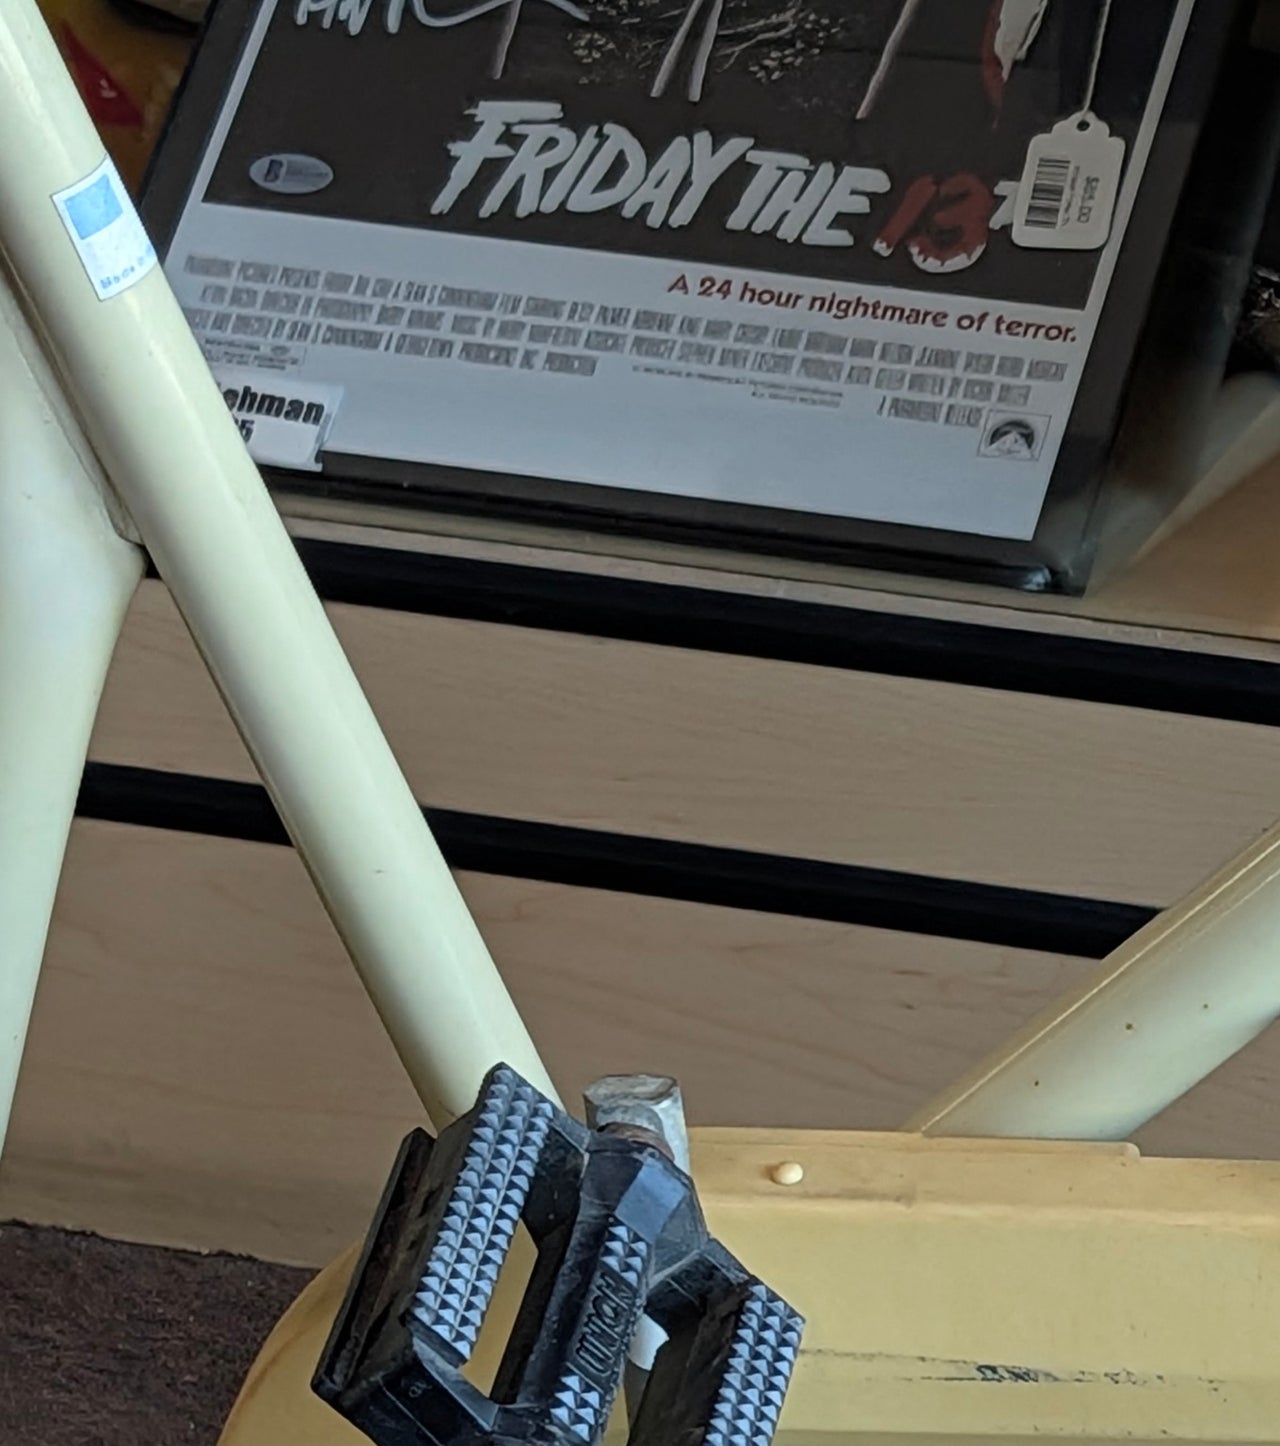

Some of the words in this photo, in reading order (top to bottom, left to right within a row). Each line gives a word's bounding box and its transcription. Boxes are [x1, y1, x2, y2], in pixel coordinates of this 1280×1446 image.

[430, 100, 755, 230] FRIDAY
[725, 149, 891, 246] THE
[667, 273, 689, 296] A
[697, 276, 733, 300] 24
[739, 281, 803, 310] hour
[808, 291, 948, 329] nightmare
[956, 311, 991, 332] of
[994, 315, 1078, 344] terror.
